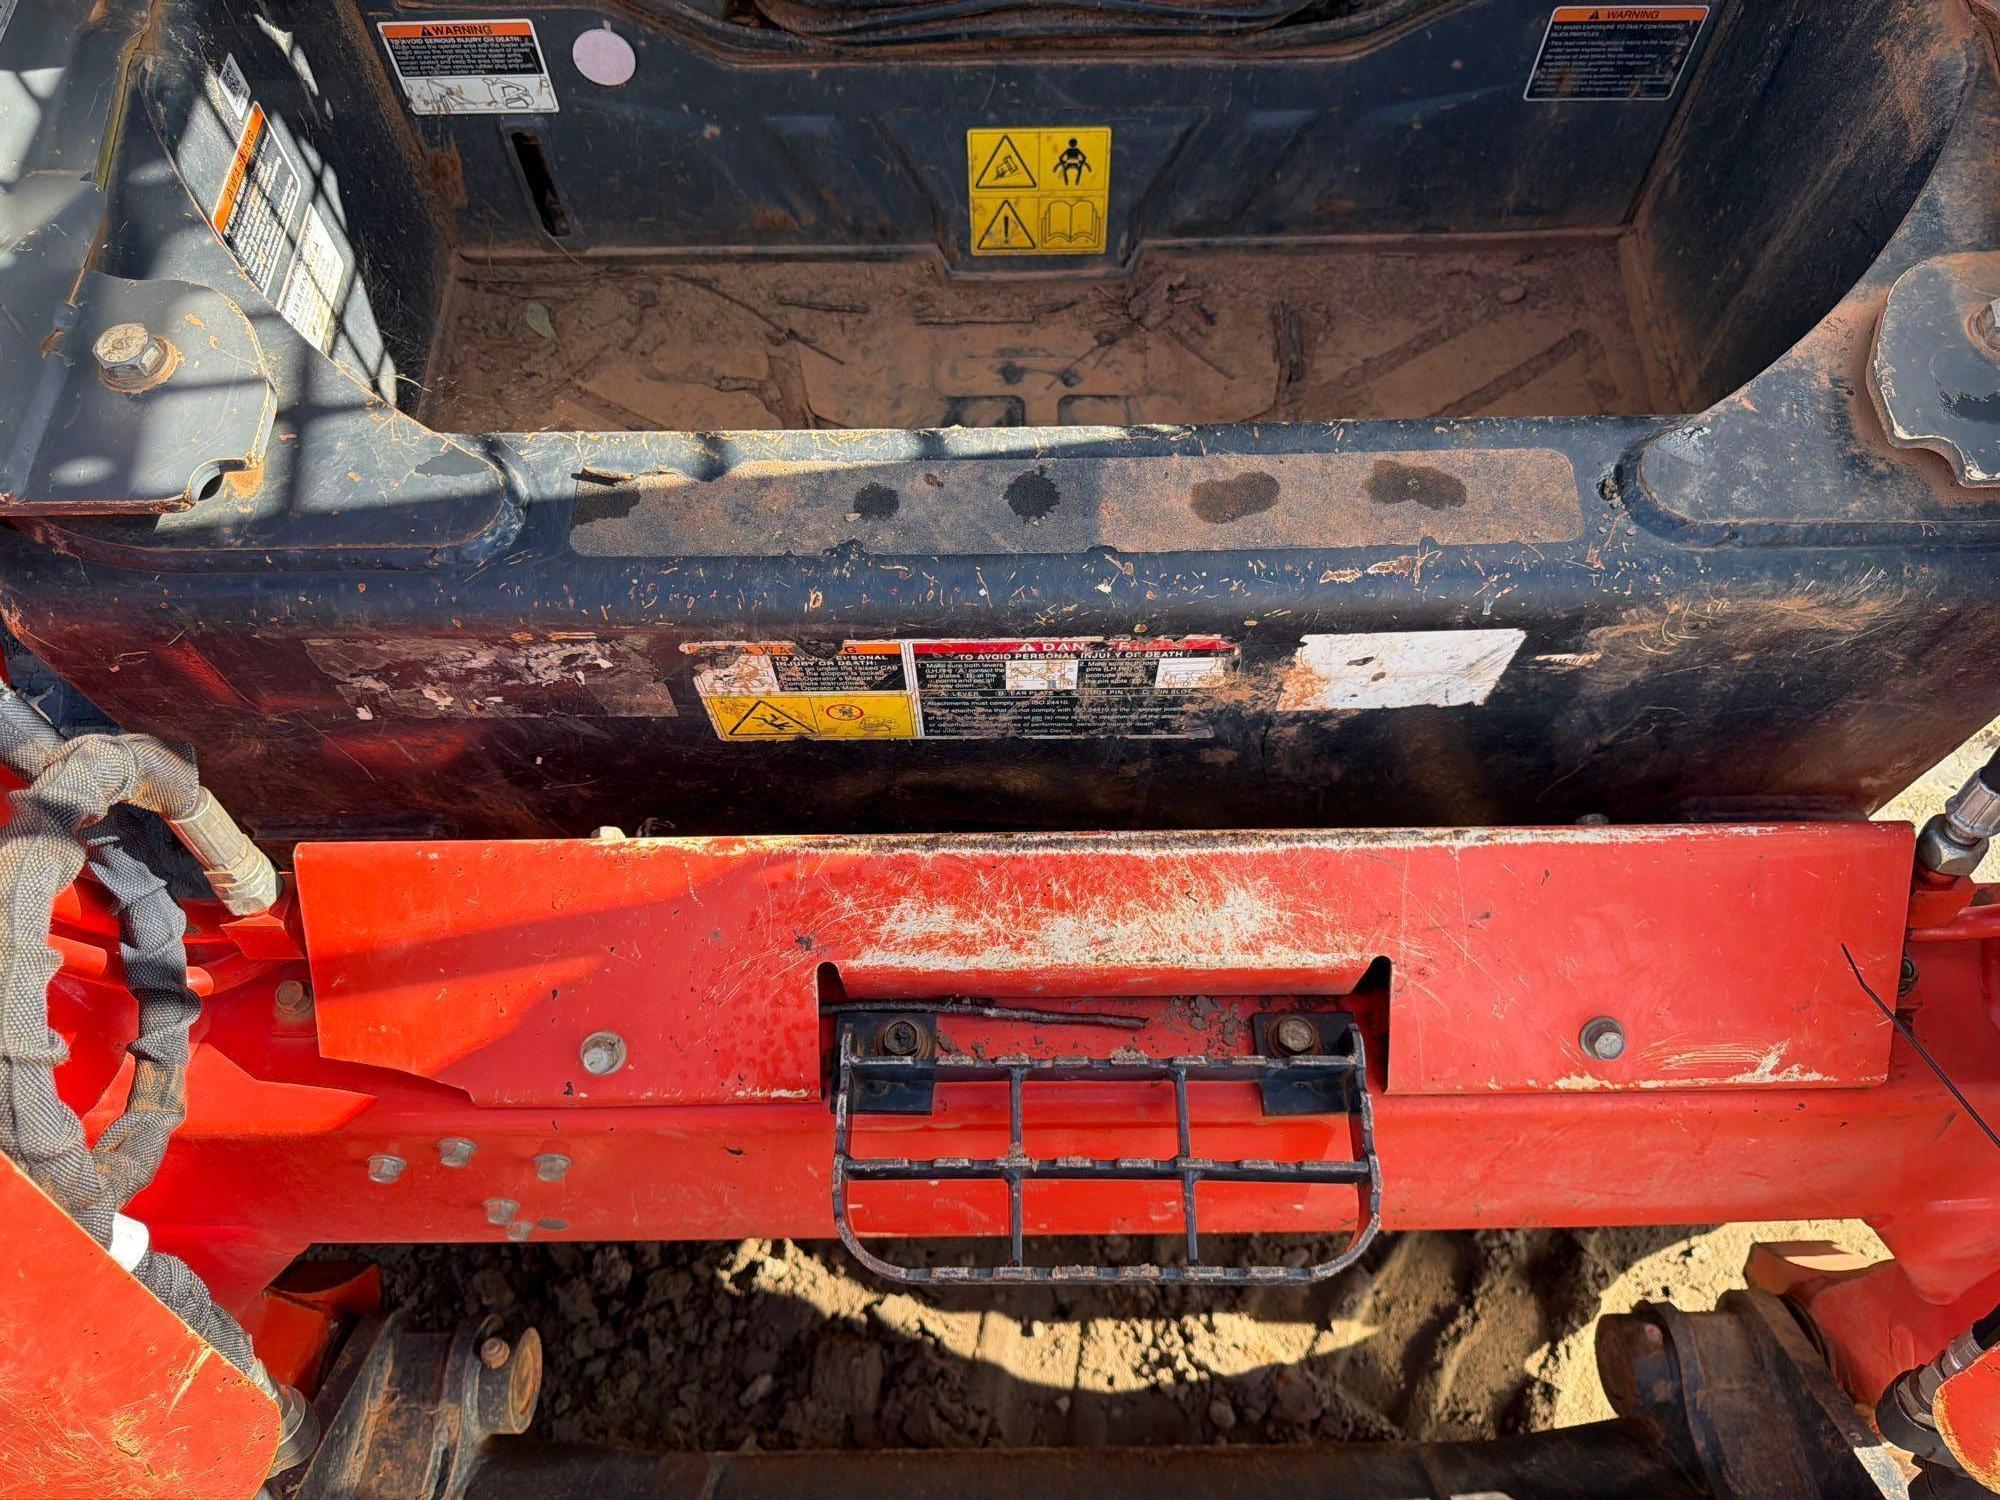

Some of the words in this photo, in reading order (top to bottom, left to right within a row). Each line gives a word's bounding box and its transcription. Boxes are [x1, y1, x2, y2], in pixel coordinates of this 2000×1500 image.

[1607, 9, 1660, 19] WARNING
[431, 25, 492, 35] WARNING
[229, 127, 255, 190] WARNING
[1042, 643, 1130, 651] DANR
[1015, 652, 1077, 660] PERSONAL
